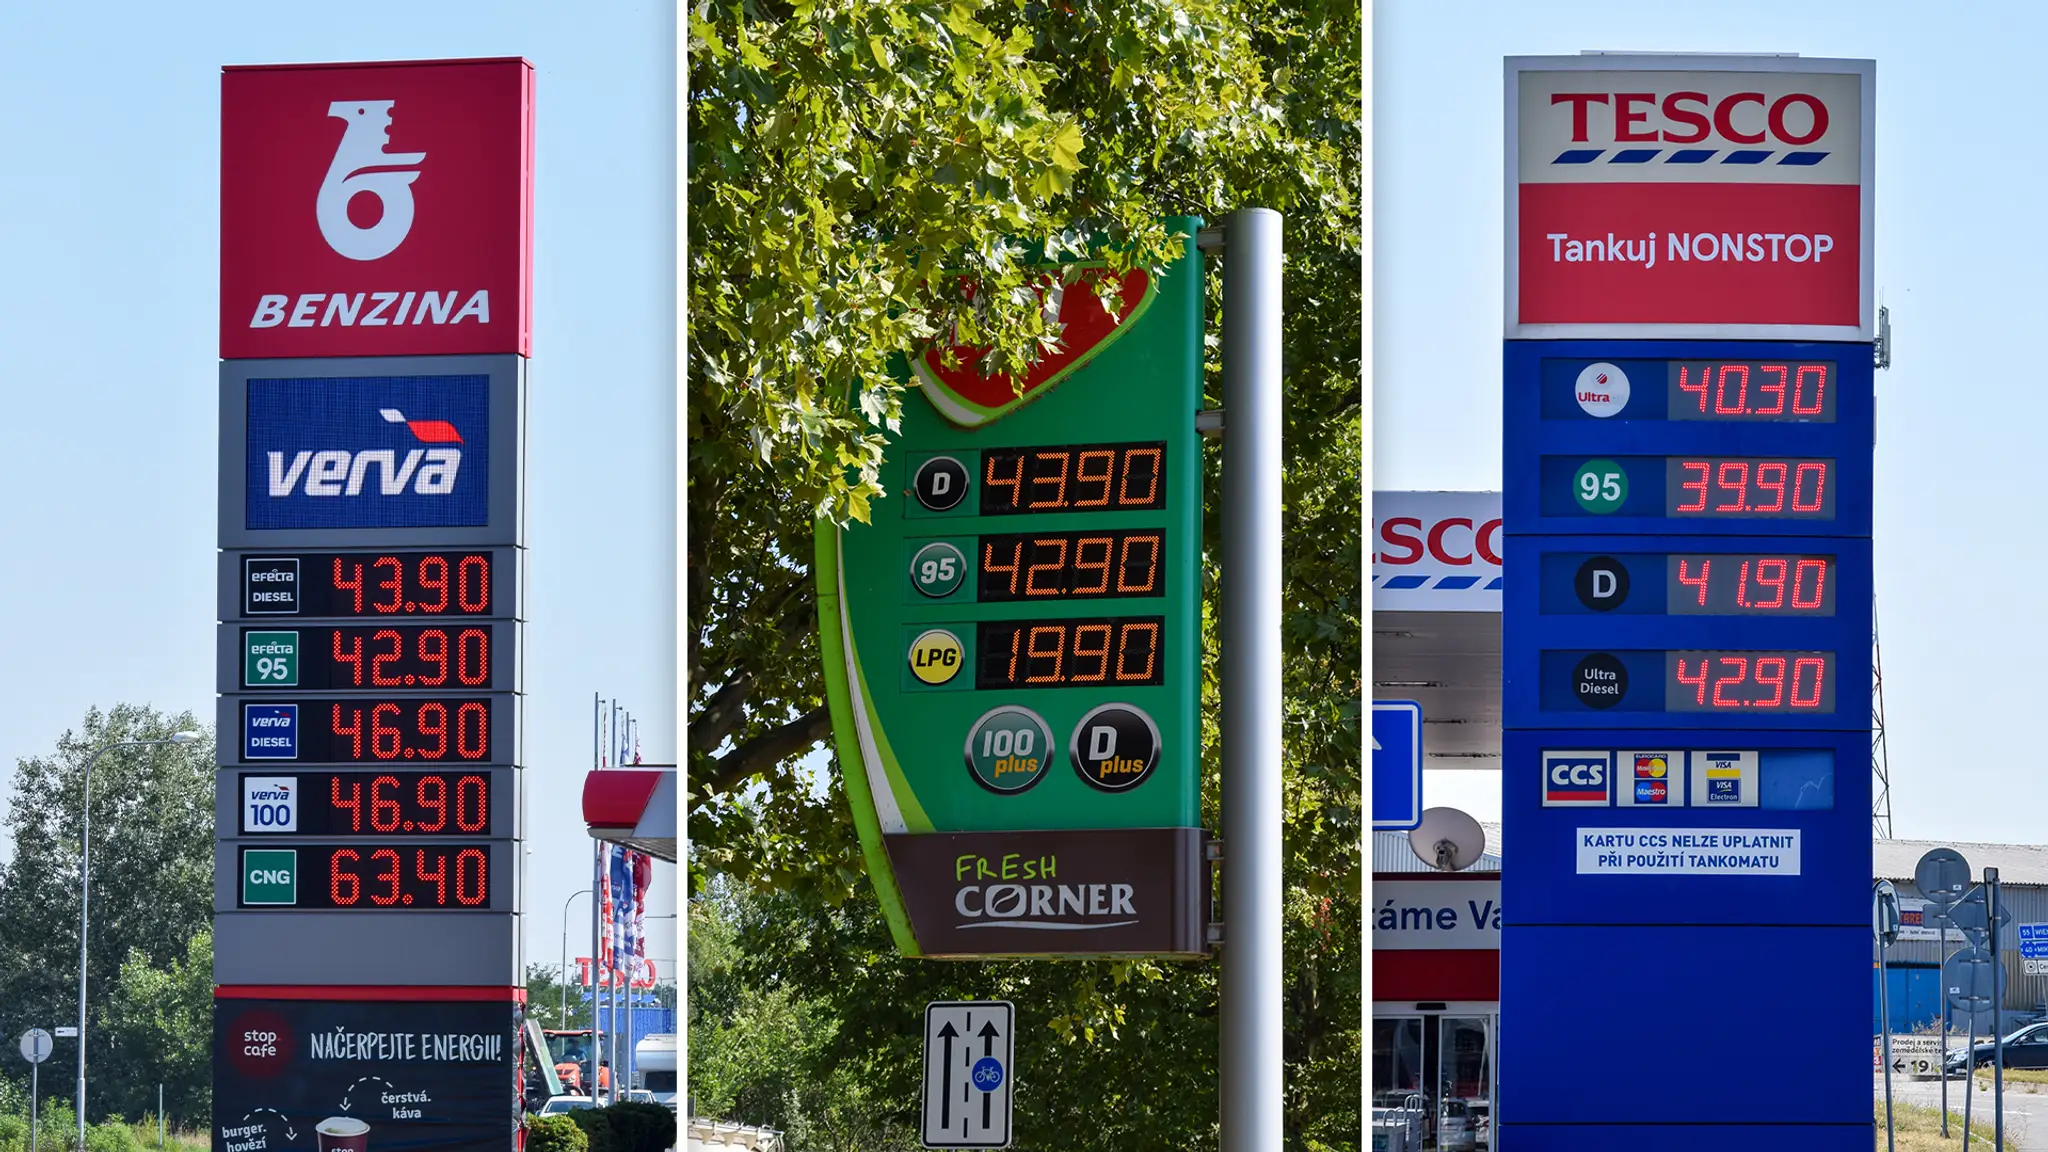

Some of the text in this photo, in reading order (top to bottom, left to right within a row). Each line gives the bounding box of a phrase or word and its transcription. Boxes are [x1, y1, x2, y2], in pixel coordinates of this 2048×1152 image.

[1551, 91, 1829, 145] TESCO
[1547, 232, 1834, 269] Tankuj NONSTOP
[249, 290, 490, 328] BENZINA
[1578, 391, 1610, 403] Ultra
[1679, 365, 1827, 415] 40.30
[267, 449, 462, 497] verva
[932, 472, 951, 496] D
[986, 448, 1161, 509] 43.90
[1580, 473, 1621, 502] 95
[1677, 462, 1827, 512] 39.90
[1372, 517, 1502, 566] SCO
[920, 557, 956, 585] 95
[984, 535, 1160, 596] 42.90
[333, 556, 488, 613] 43.90
[1593, 569, 1617, 598] D
[1678, 558, 1827, 609] 41.90
[253, 591, 294, 602] DIESEL
[333, 629, 488, 686] 42.90
[915, 646, 957, 669] LPG
[1008, 622, 1159, 683] 19.90
[256, 658, 288, 681] 95
[1584, 668, 1616, 681] Ultra
[1580, 681, 1619, 695] Diesel
[1677, 657, 1825, 707] 42.90
[252, 716, 291, 727] verva
[332, 702, 487, 759] 46.90
[251, 737, 292, 747] DIESEL
[981, 729, 1035, 758] 100
[1088, 726, 1118, 761] D
[994, 754, 1039, 779] plus
[1100, 755, 1144, 779] plus
[1551, 764, 1603, 785] CCS
[1715, 761, 1732, 769] VISA
[251, 789, 290, 801] verva
[1636, 787, 1666, 796] Maestro
[1716, 781, 1732, 789] VISA
[251, 804, 291, 826] 100
[331, 776, 487, 832] 46.90
[1584, 834, 1794, 849] KARTU CCS NELZE UPLATNIT
[956, 854, 1057, 882] FRESH
[1598, 851, 1779, 868] PŘI POUŽITÍ TANKOMATU
[250, 869, 291, 885] CNG
[330, 849, 486, 905] 63.40
[955, 883, 1137, 918] CORNER
[244, 1044, 277, 1058] cafe
[311, 1026, 501, 1062] NAČERPEJTE ENERGII!
[1892, 1038, 1916, 1047] Prodej
[1911, 1060, 1929, 1073] 19
[381, 1089, 431, 1104] čerstvá.
[392, 1106, 422, 1119] káva
[222, 1124, 267, 1139] burger.
[226, 1136, 267, 1152] hovězí
